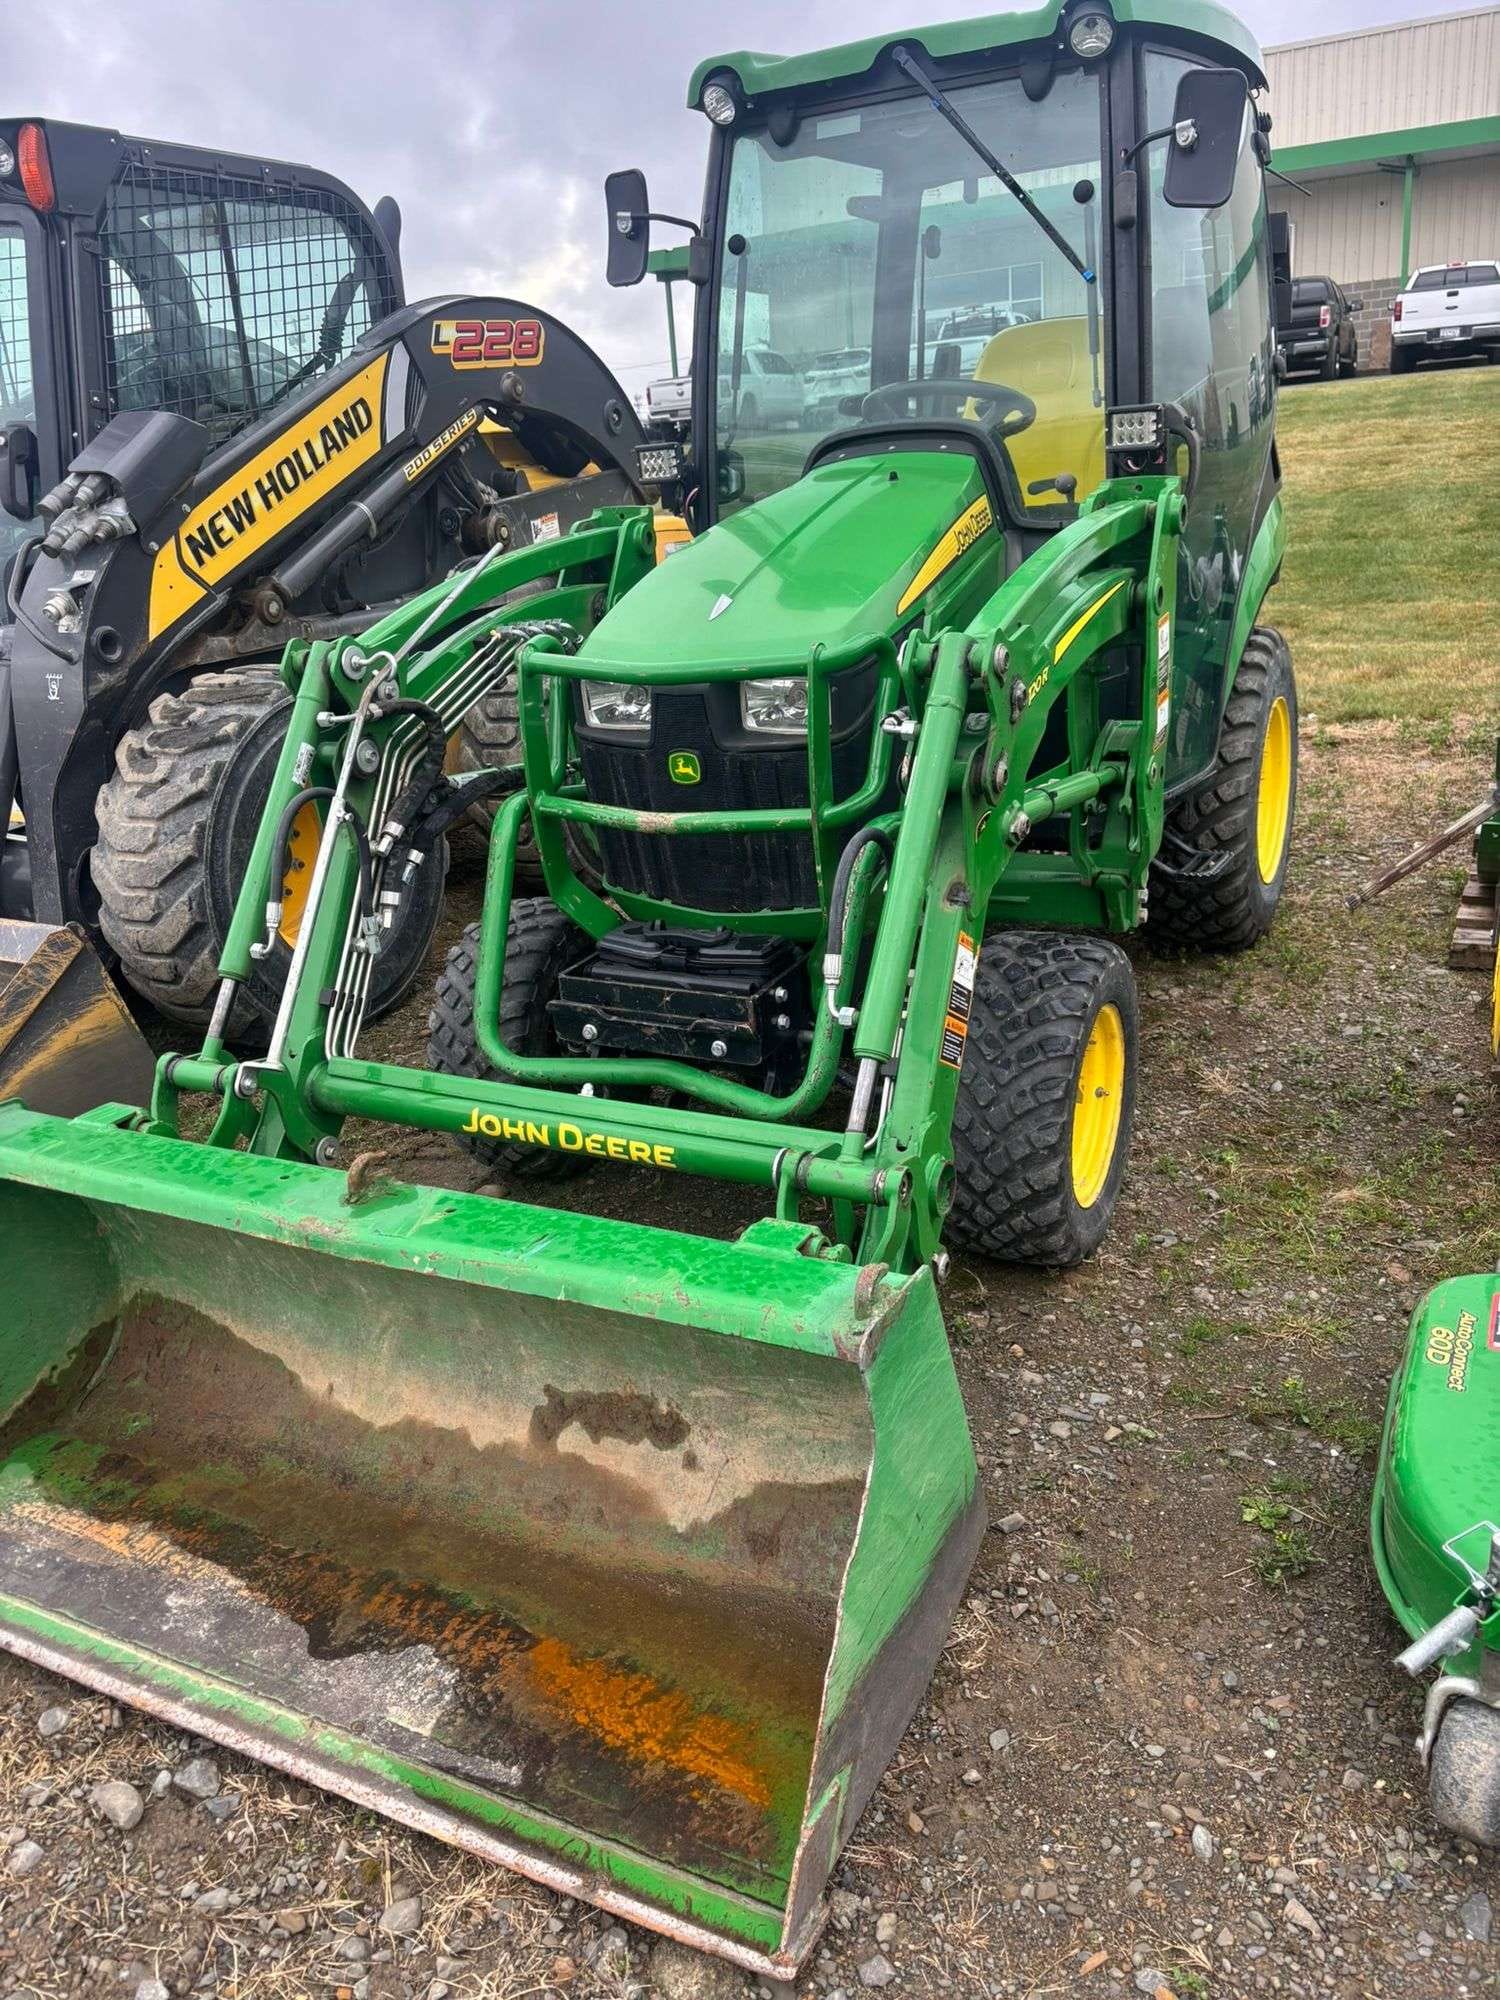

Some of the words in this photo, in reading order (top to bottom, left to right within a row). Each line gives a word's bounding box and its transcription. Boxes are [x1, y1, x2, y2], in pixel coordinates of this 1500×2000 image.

[431, 320, 544, 369] L228
[403, 449, 432, 479] 200
[432, 409, 478, 453] SERIES
[184, 488, 257, 568] NEW
[253, 396, 373, 512] HOLLAND
[953, 521, 976, 555] JOHN
[462, 1107, 550, 1147] JOHN
[558, 1121, 678, 1169] DEERE
[1426, 1326, 1455, 1366] 60D
[1447, 1309, 1478, 1392] AutoConnect
